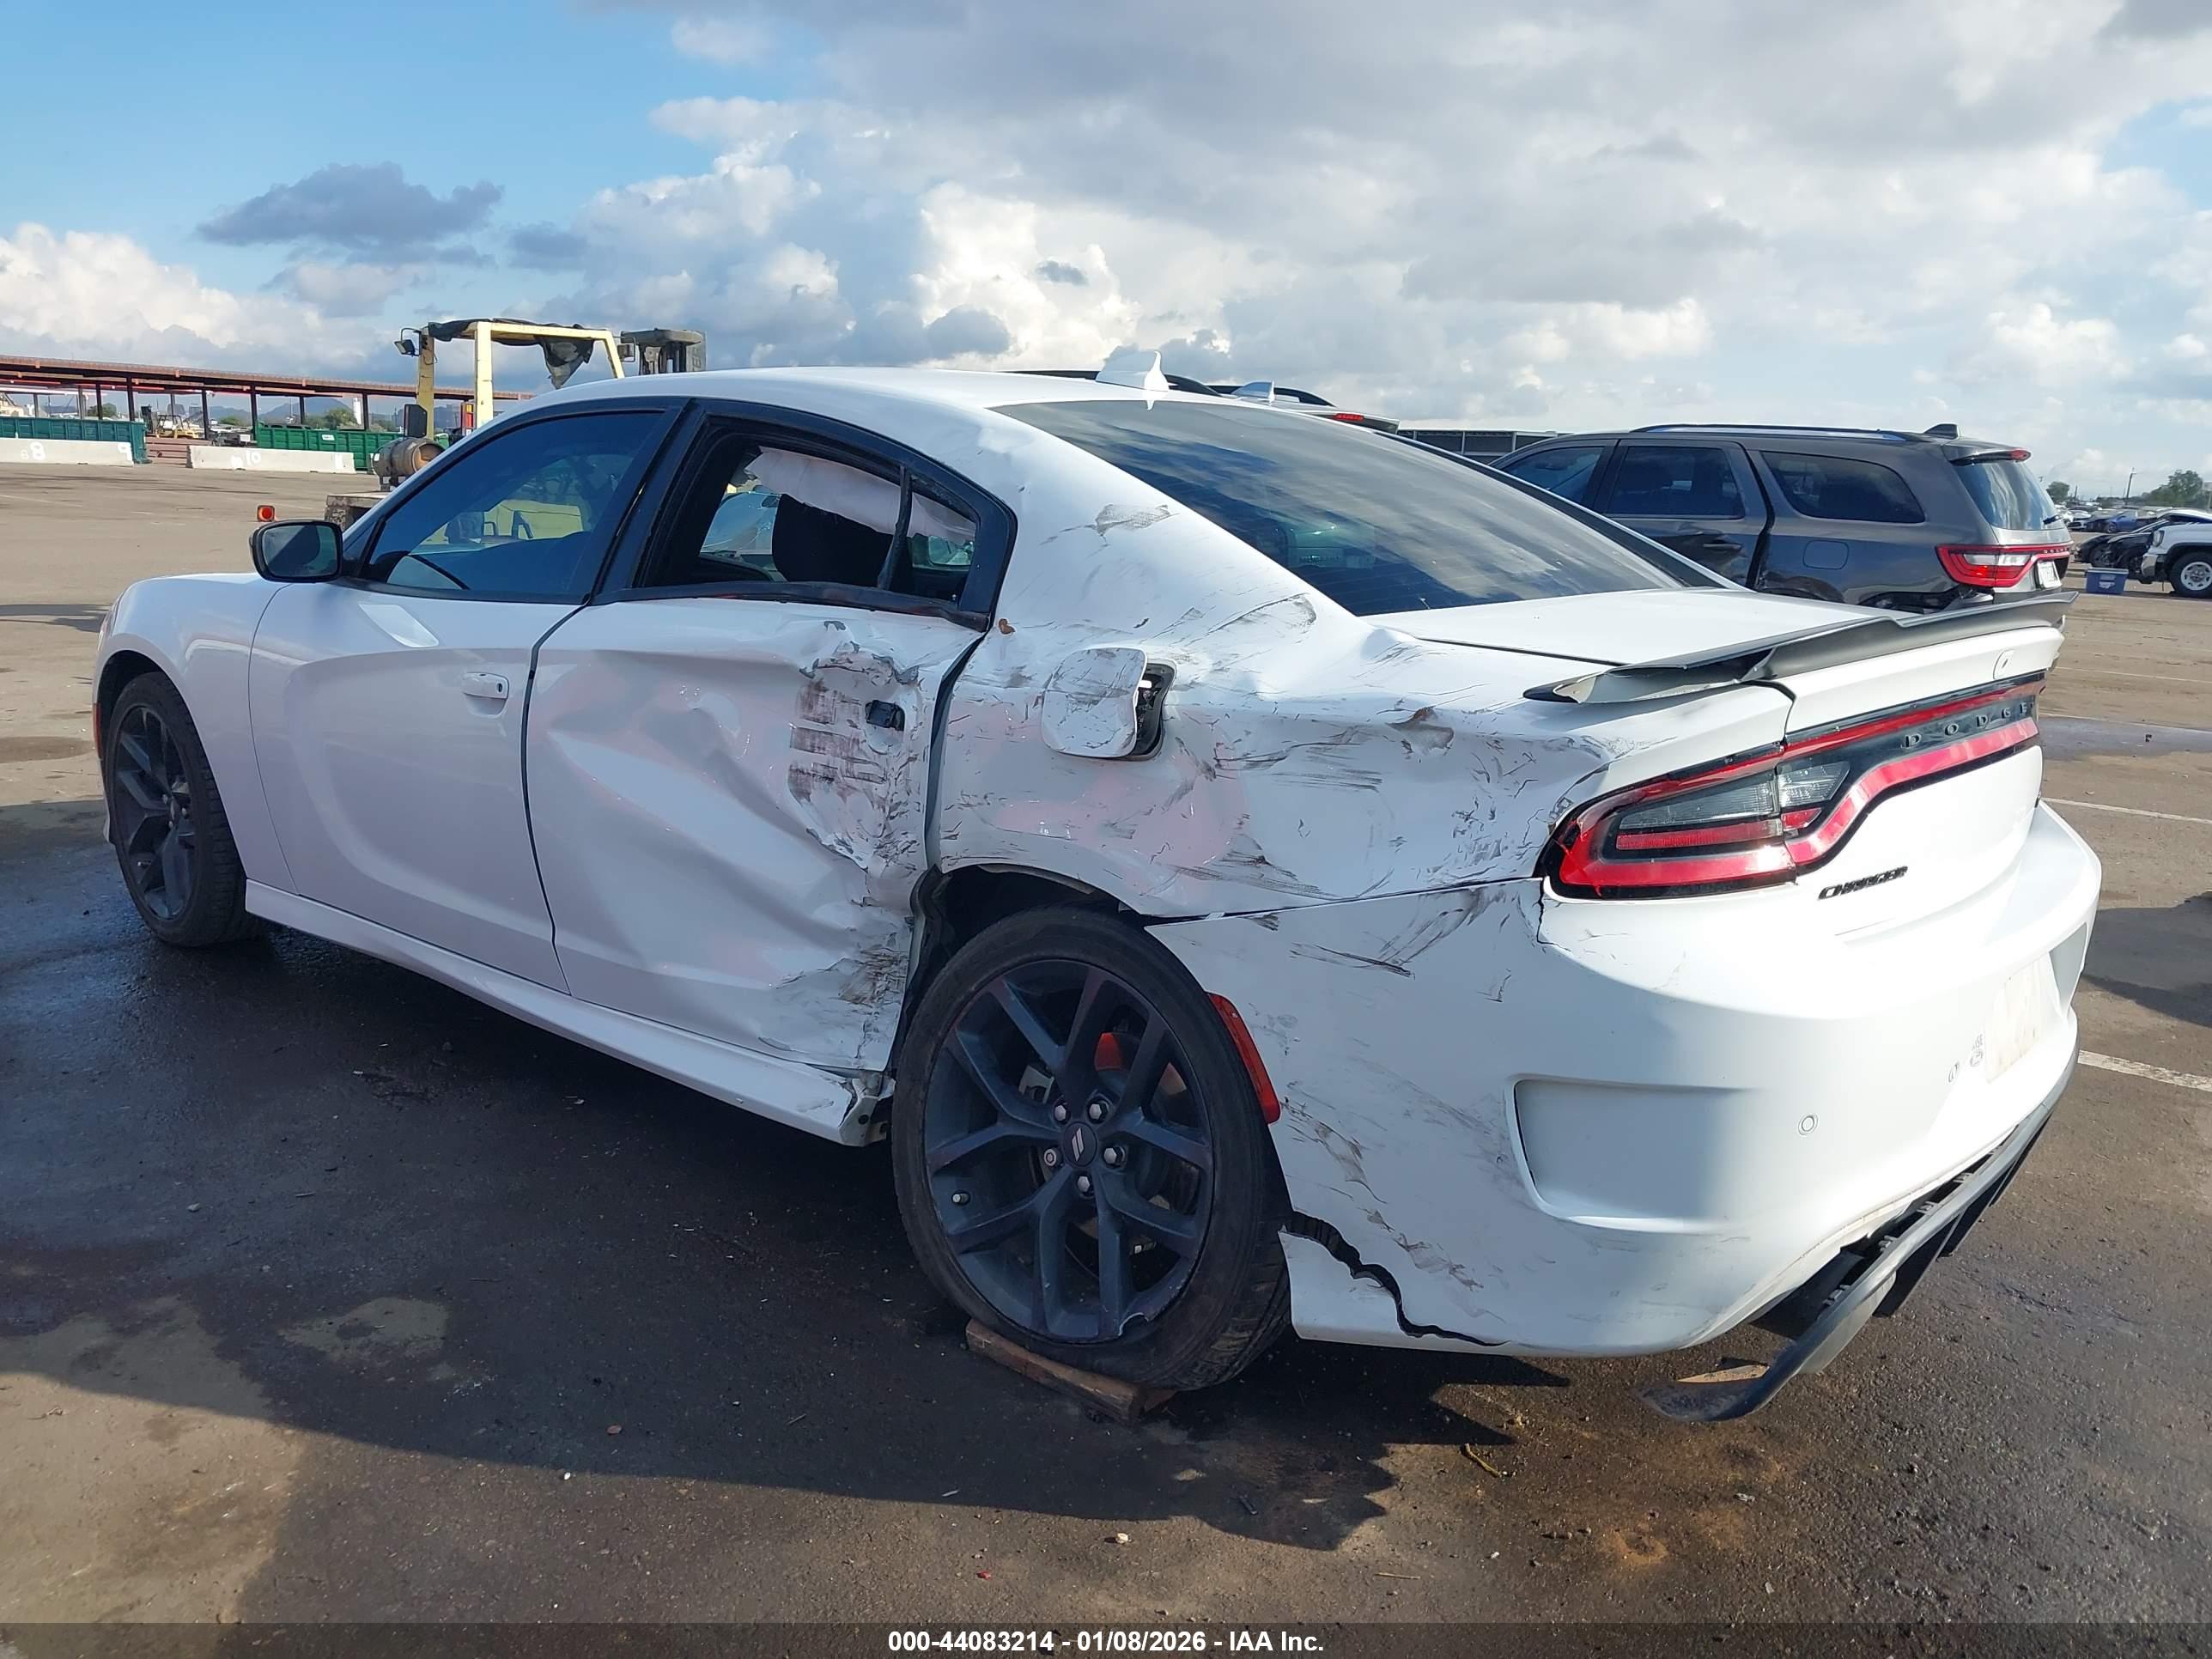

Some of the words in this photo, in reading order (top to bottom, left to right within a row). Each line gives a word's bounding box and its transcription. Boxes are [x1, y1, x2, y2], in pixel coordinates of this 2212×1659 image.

[30, 441, 46, 460] 8
[118, 442, 132, 461] 9
[1904, 702, 2027, 748] DODGE
[1819, 866, 1908, 899] CHARGER
